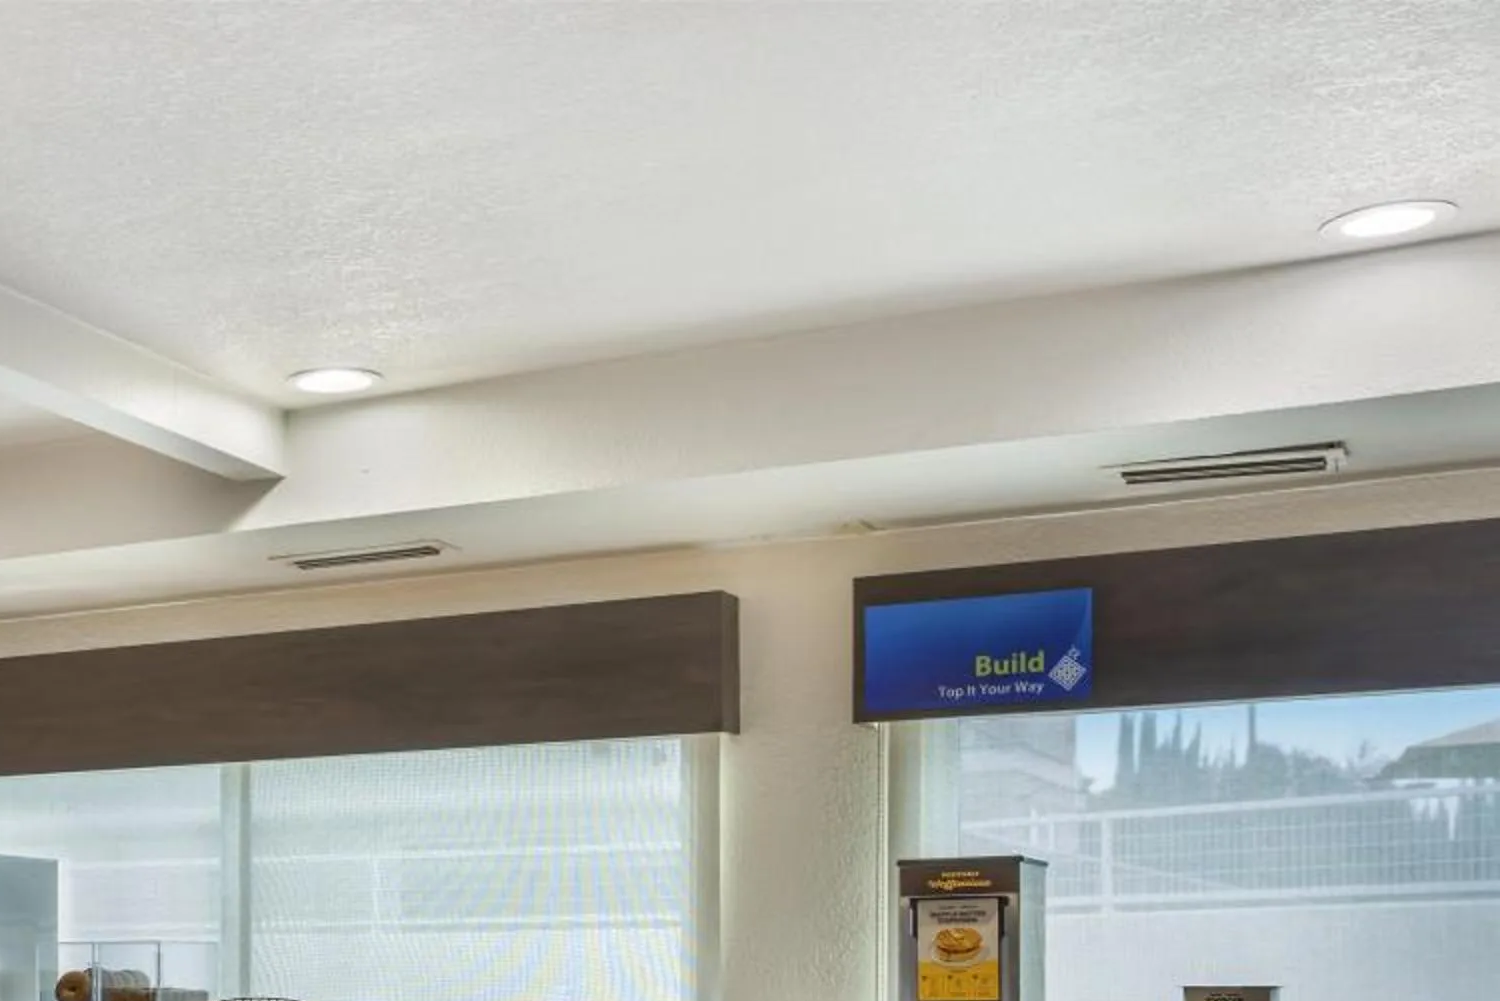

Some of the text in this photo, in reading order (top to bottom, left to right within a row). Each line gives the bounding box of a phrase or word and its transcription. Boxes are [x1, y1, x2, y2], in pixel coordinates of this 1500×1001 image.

[975, 650, 1045, 677] Build
[938, 680, 1044, 700] Top It Your Way
